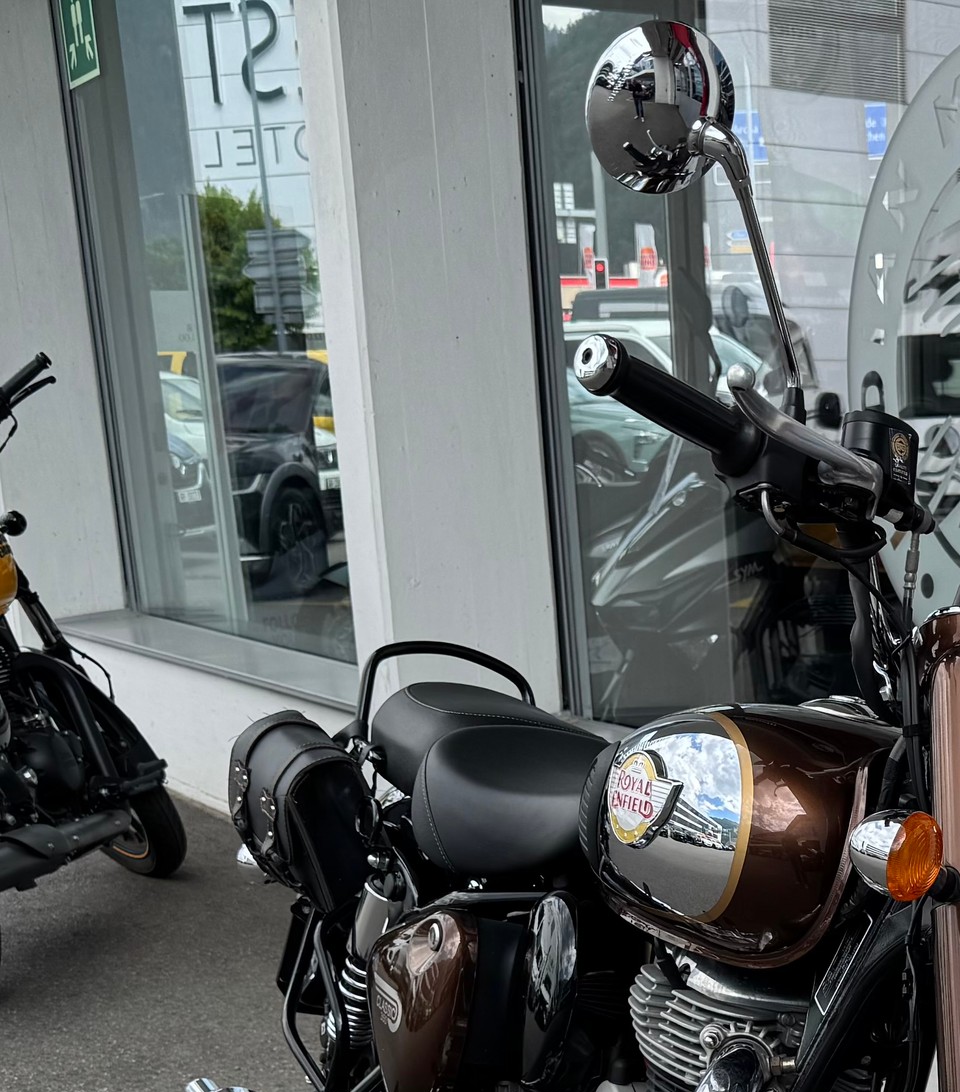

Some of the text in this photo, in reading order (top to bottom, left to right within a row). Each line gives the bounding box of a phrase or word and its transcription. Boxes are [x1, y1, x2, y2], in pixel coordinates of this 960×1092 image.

[617, 769, 652, 797] ROYAL
[611, 789, 654, 819] ENFIELD
[376, 995, 397, 1020] CLASSIC
